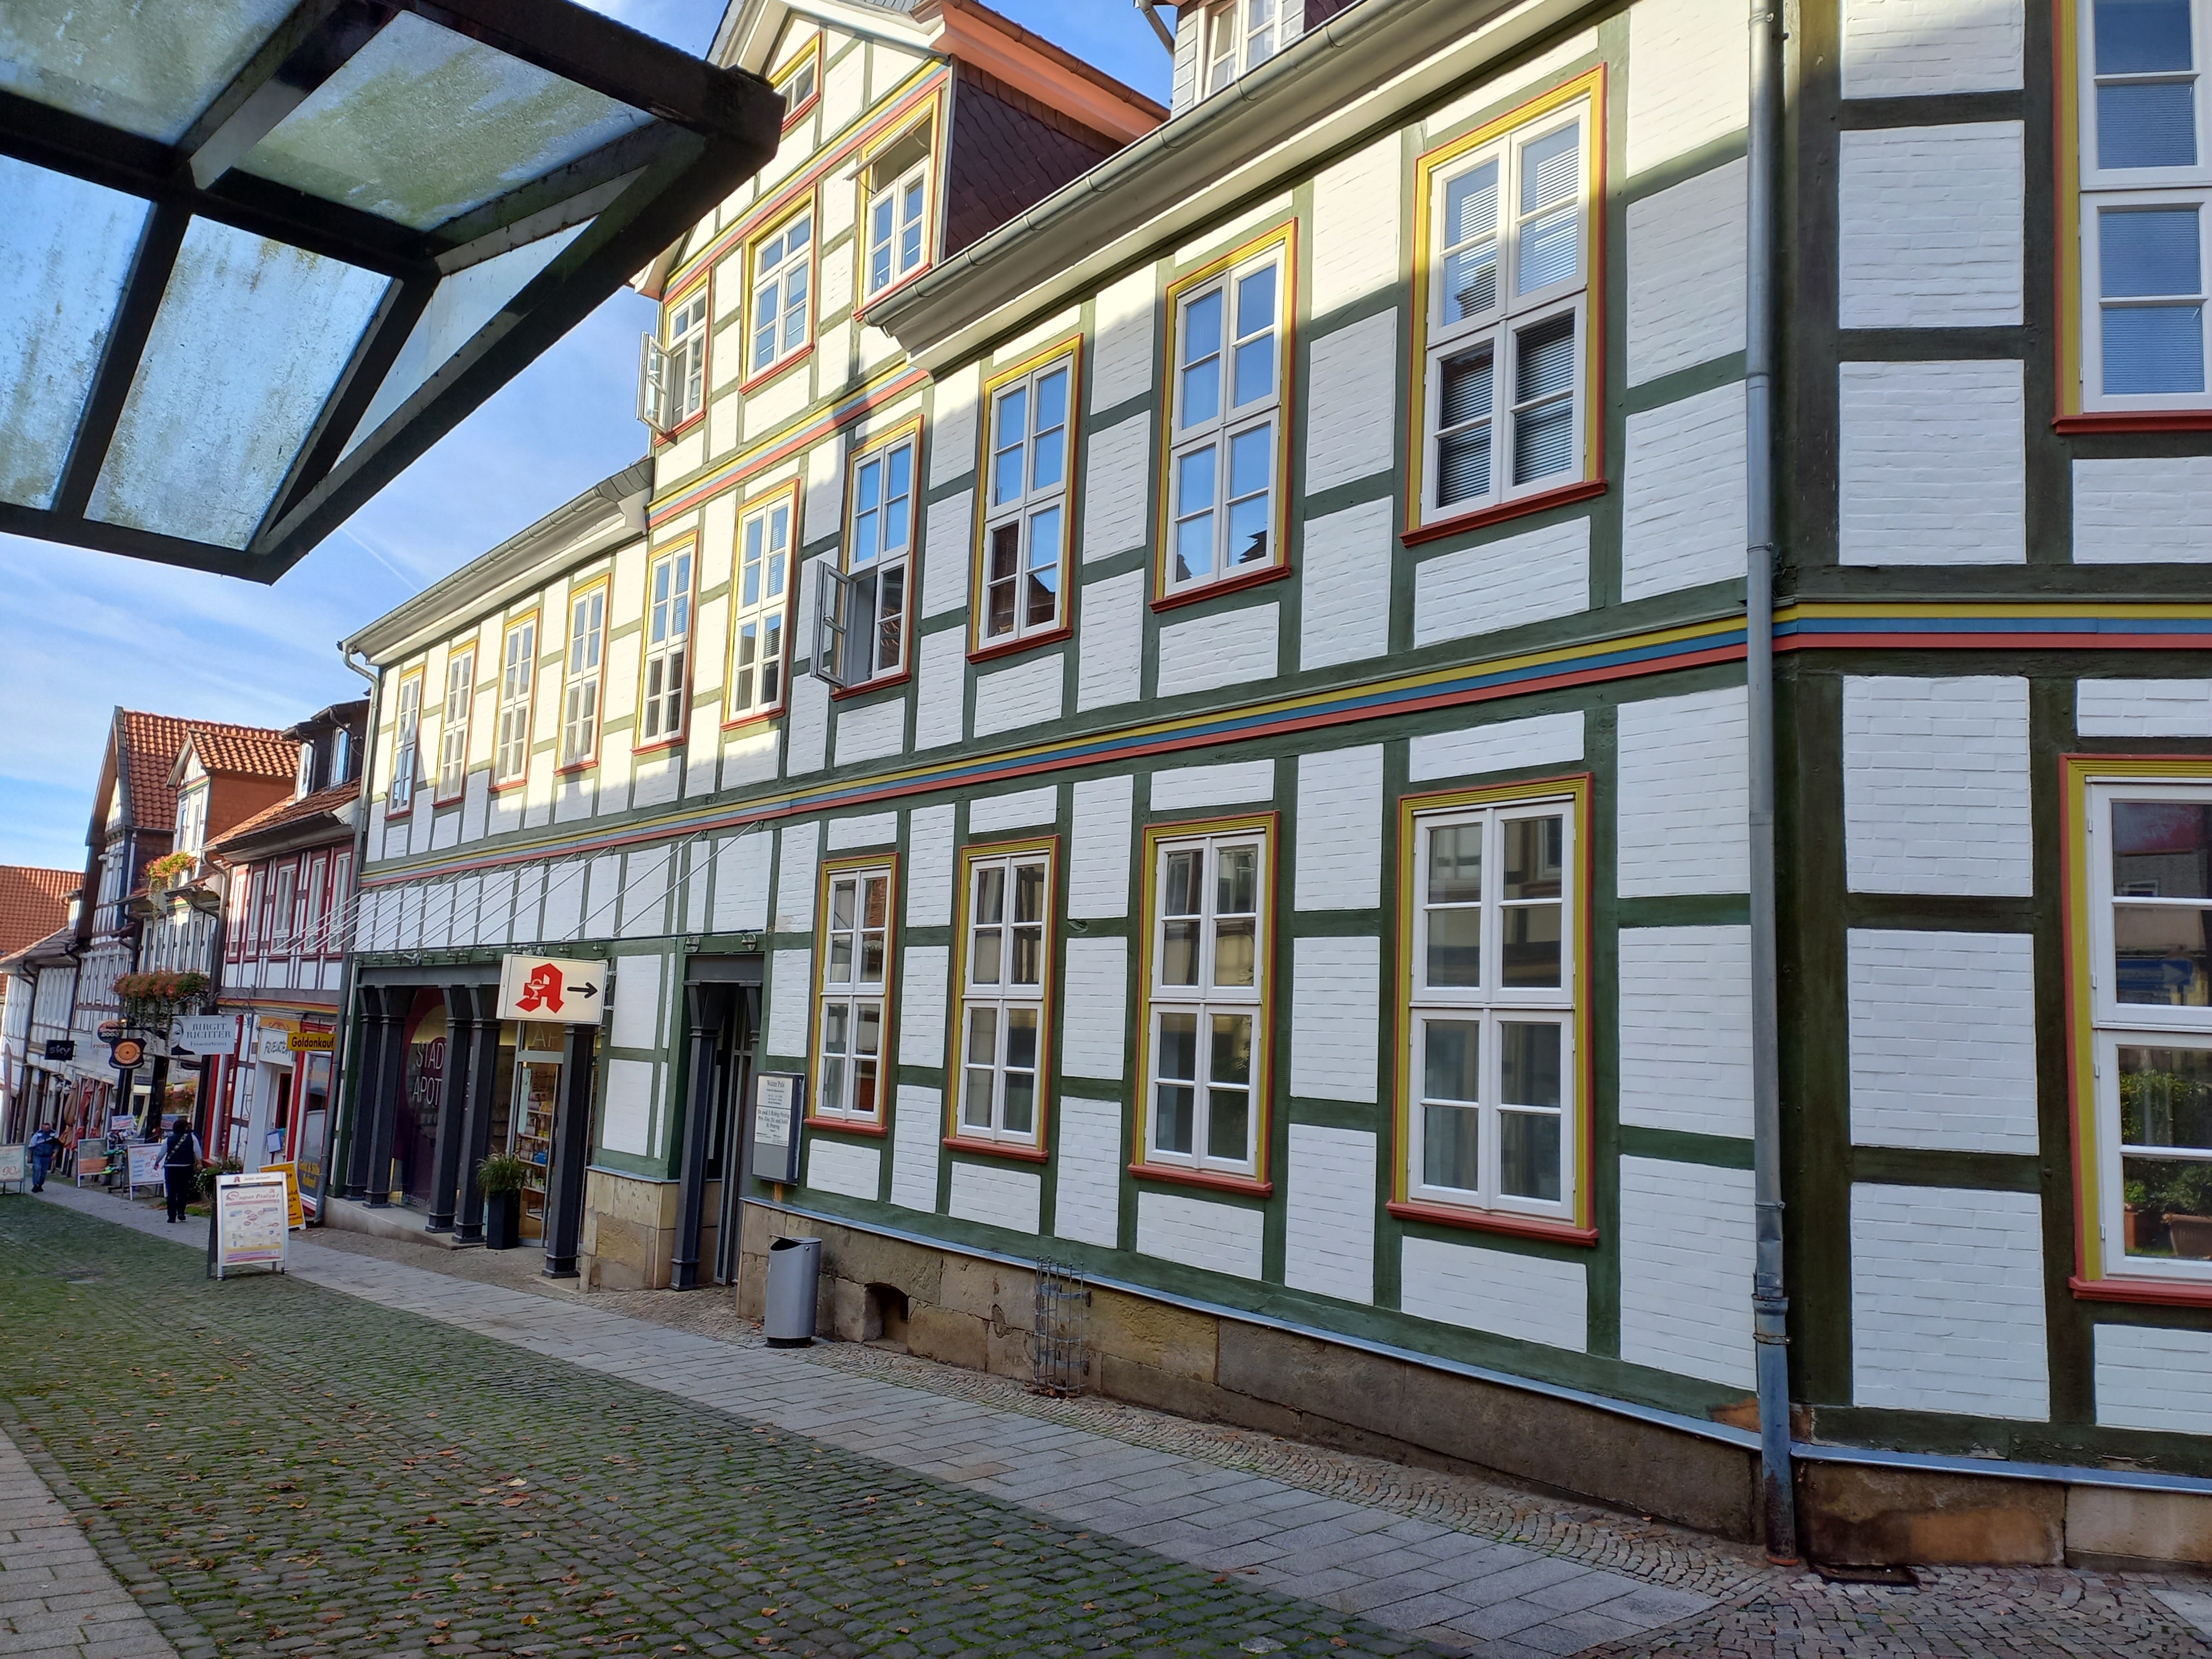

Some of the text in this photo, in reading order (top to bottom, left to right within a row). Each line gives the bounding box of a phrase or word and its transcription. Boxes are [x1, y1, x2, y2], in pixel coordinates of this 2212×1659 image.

[291, 1036, 335, 1048] Goldankauf
[49, 1045, 72, 1056] sky
[416, 1041, 447, 1070] STAD
